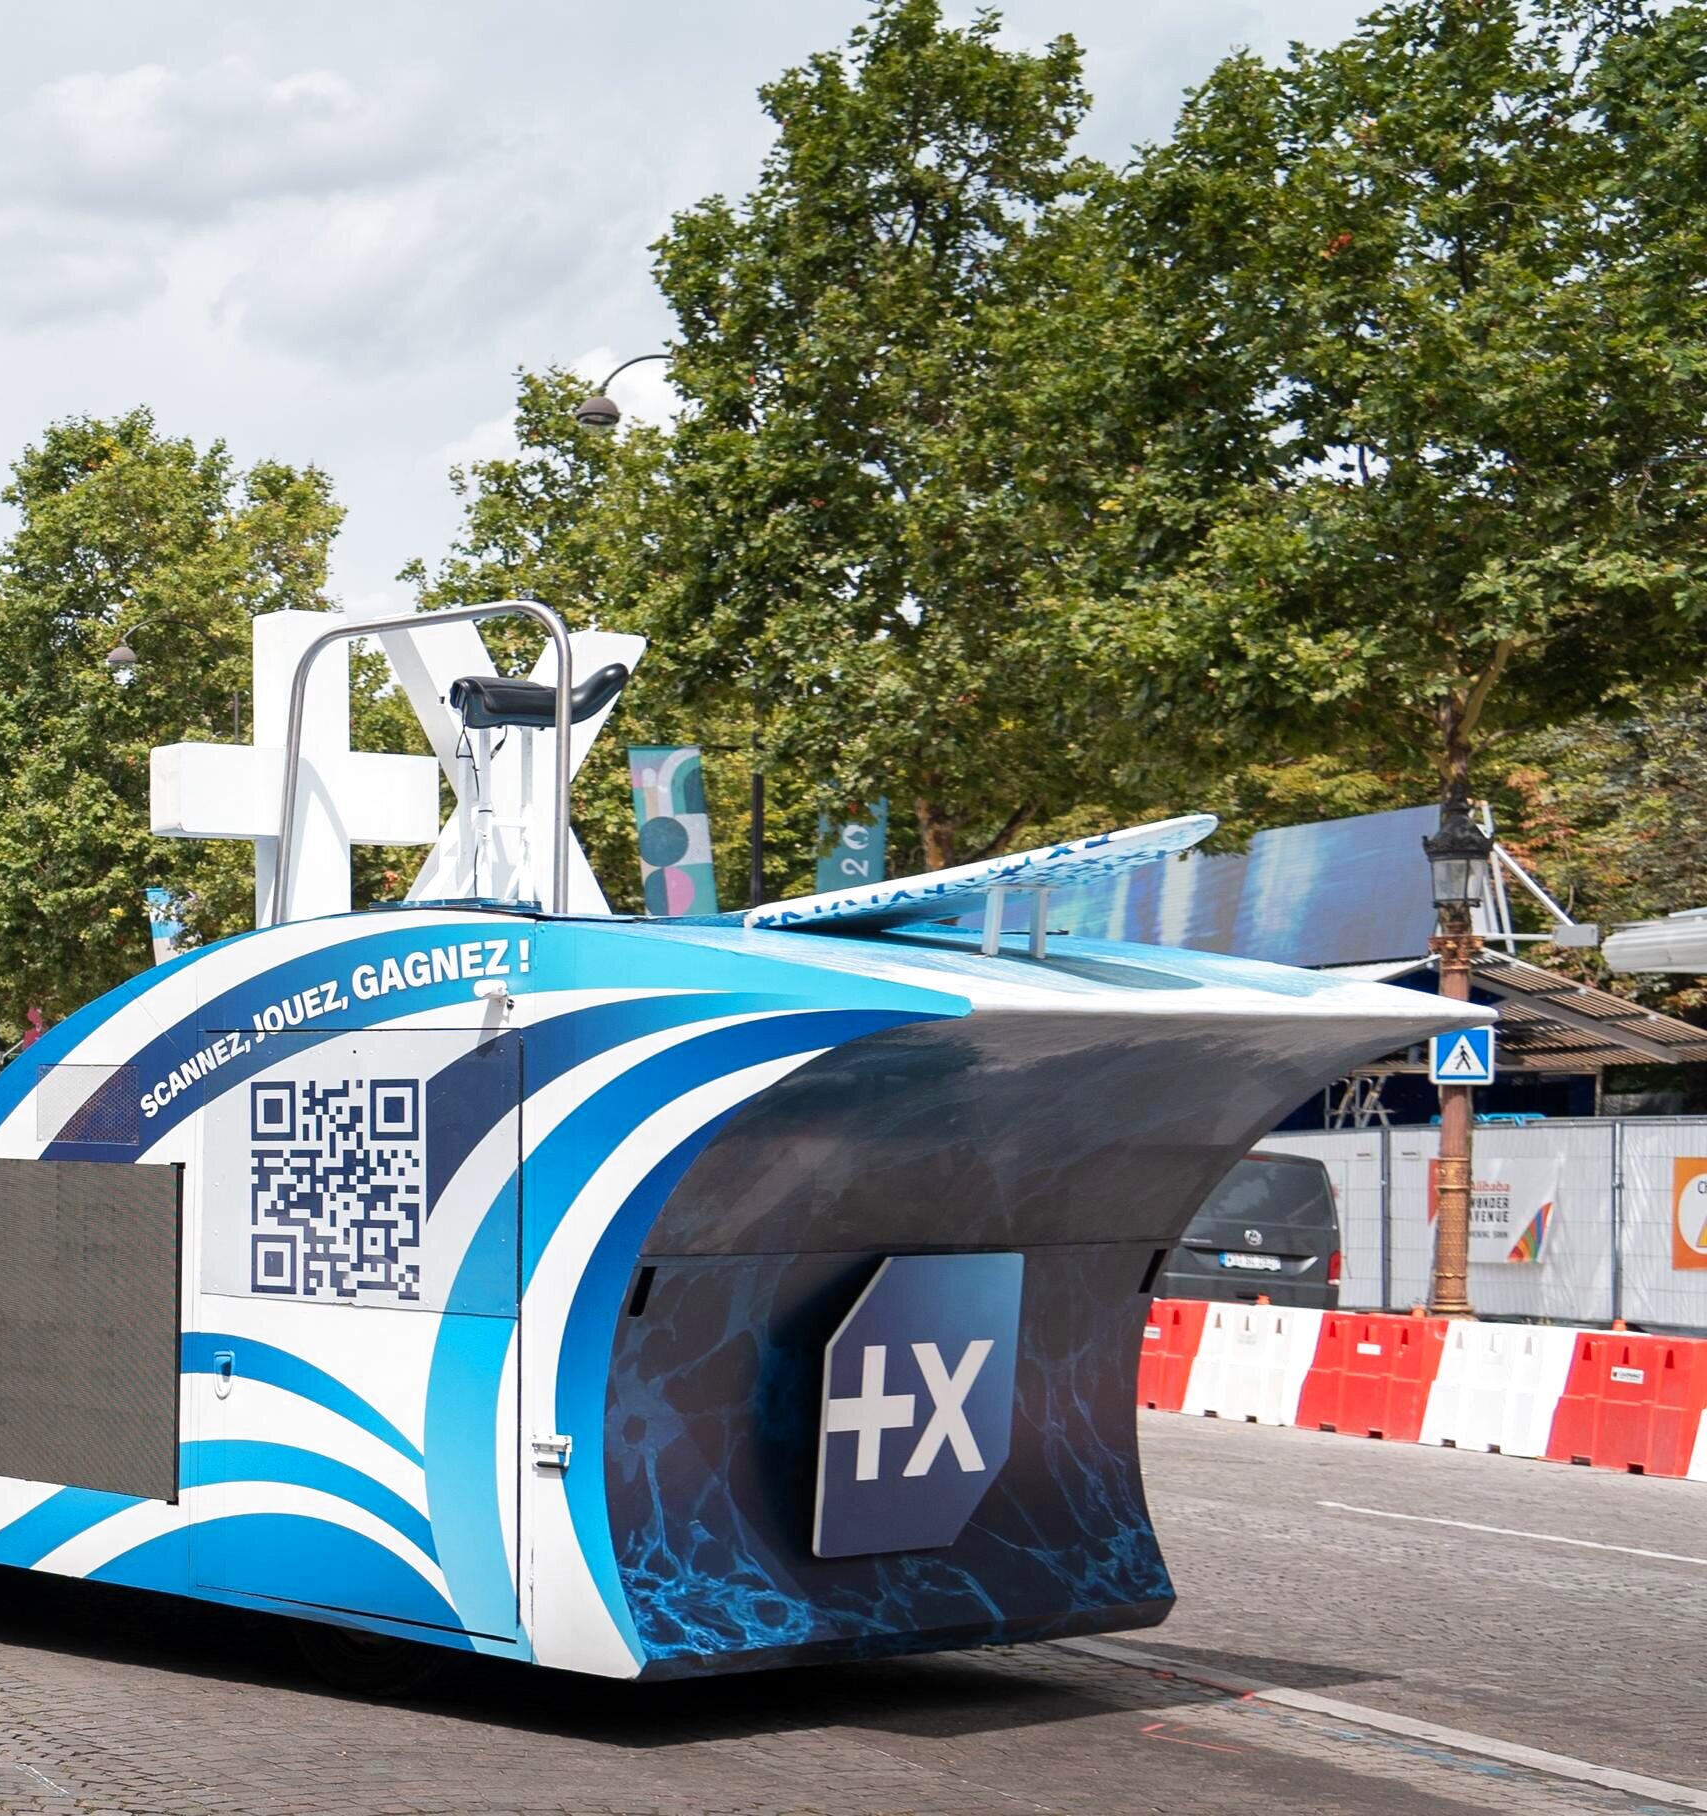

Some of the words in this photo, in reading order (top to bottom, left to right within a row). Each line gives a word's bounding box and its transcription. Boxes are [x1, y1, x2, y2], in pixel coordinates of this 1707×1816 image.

[140, 1029, 252, 1119] SCANNEZ,
[252, 980, 349, 1045] JOUEZ,
[351, 938, 510, 1001] GAGNEZ
